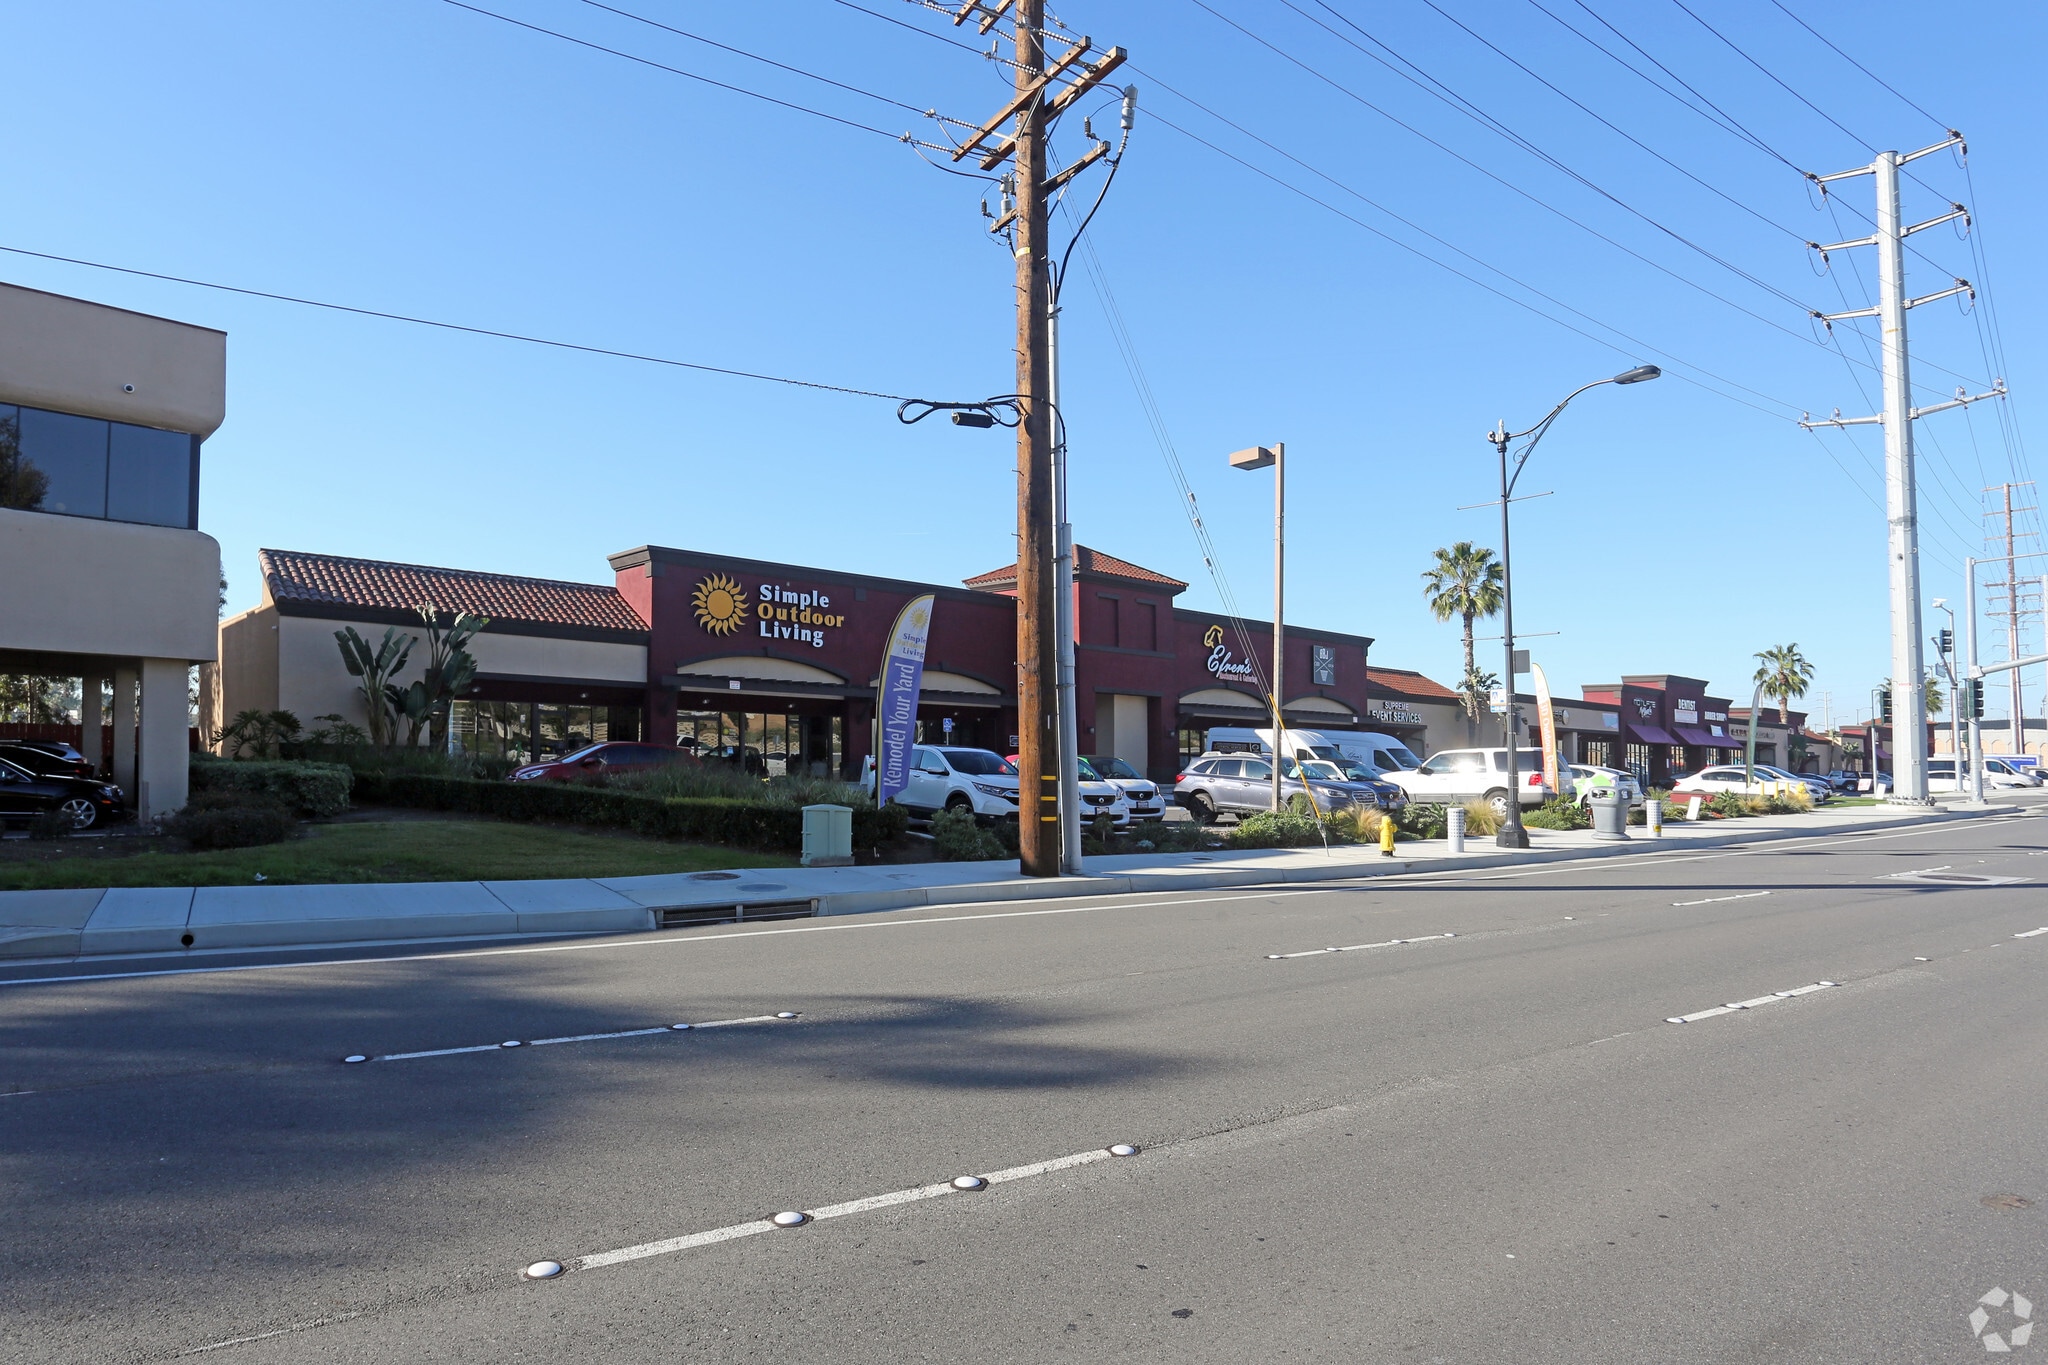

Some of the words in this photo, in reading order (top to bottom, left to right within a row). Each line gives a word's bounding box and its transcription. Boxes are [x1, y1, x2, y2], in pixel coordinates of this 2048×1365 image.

[759, 584, 830, 610] Simple
[757, 602, 845, 627] Outdoor
[759, 620, 824, 648] Living
[902, 632, 926, 644] Simple
[893, 662, 915, 692] Yard
[888, 695, 911, 726] Your
[1372, 710, 1392, 722] EVENT
[1393, 711, 1422, 724] SERVICES
[1383, 701, 1409, 711] SUPREME
[1678, 698, 1696, 711] DENTIST
[883, 727, 907, 788] Remodel
